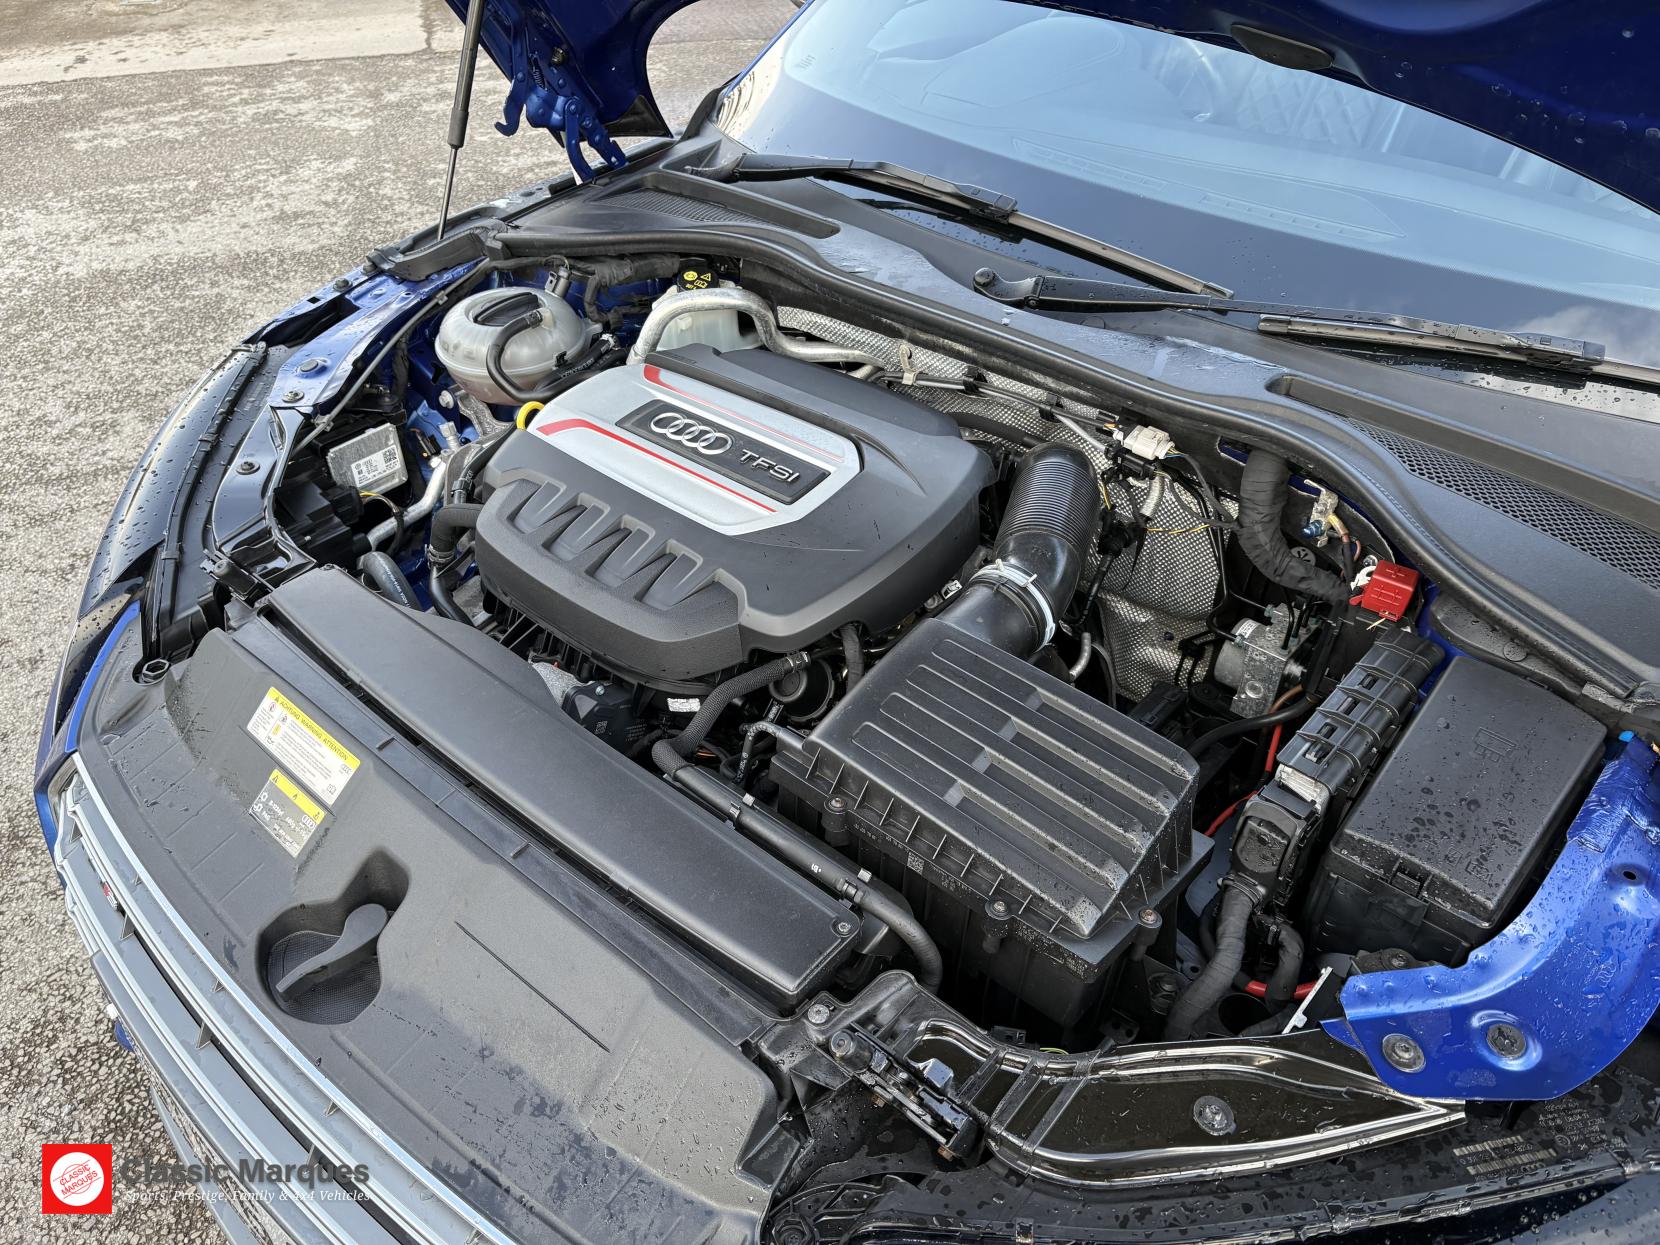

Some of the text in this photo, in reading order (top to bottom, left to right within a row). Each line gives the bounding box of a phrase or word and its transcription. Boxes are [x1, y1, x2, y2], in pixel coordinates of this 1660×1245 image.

[739, 449, 801, 482] TFSI
[279, 699, 300, 721] ACHTUNG
[301, 718, 322, 740] WARNING
[322, 733, 349, 761] ATTENTION
